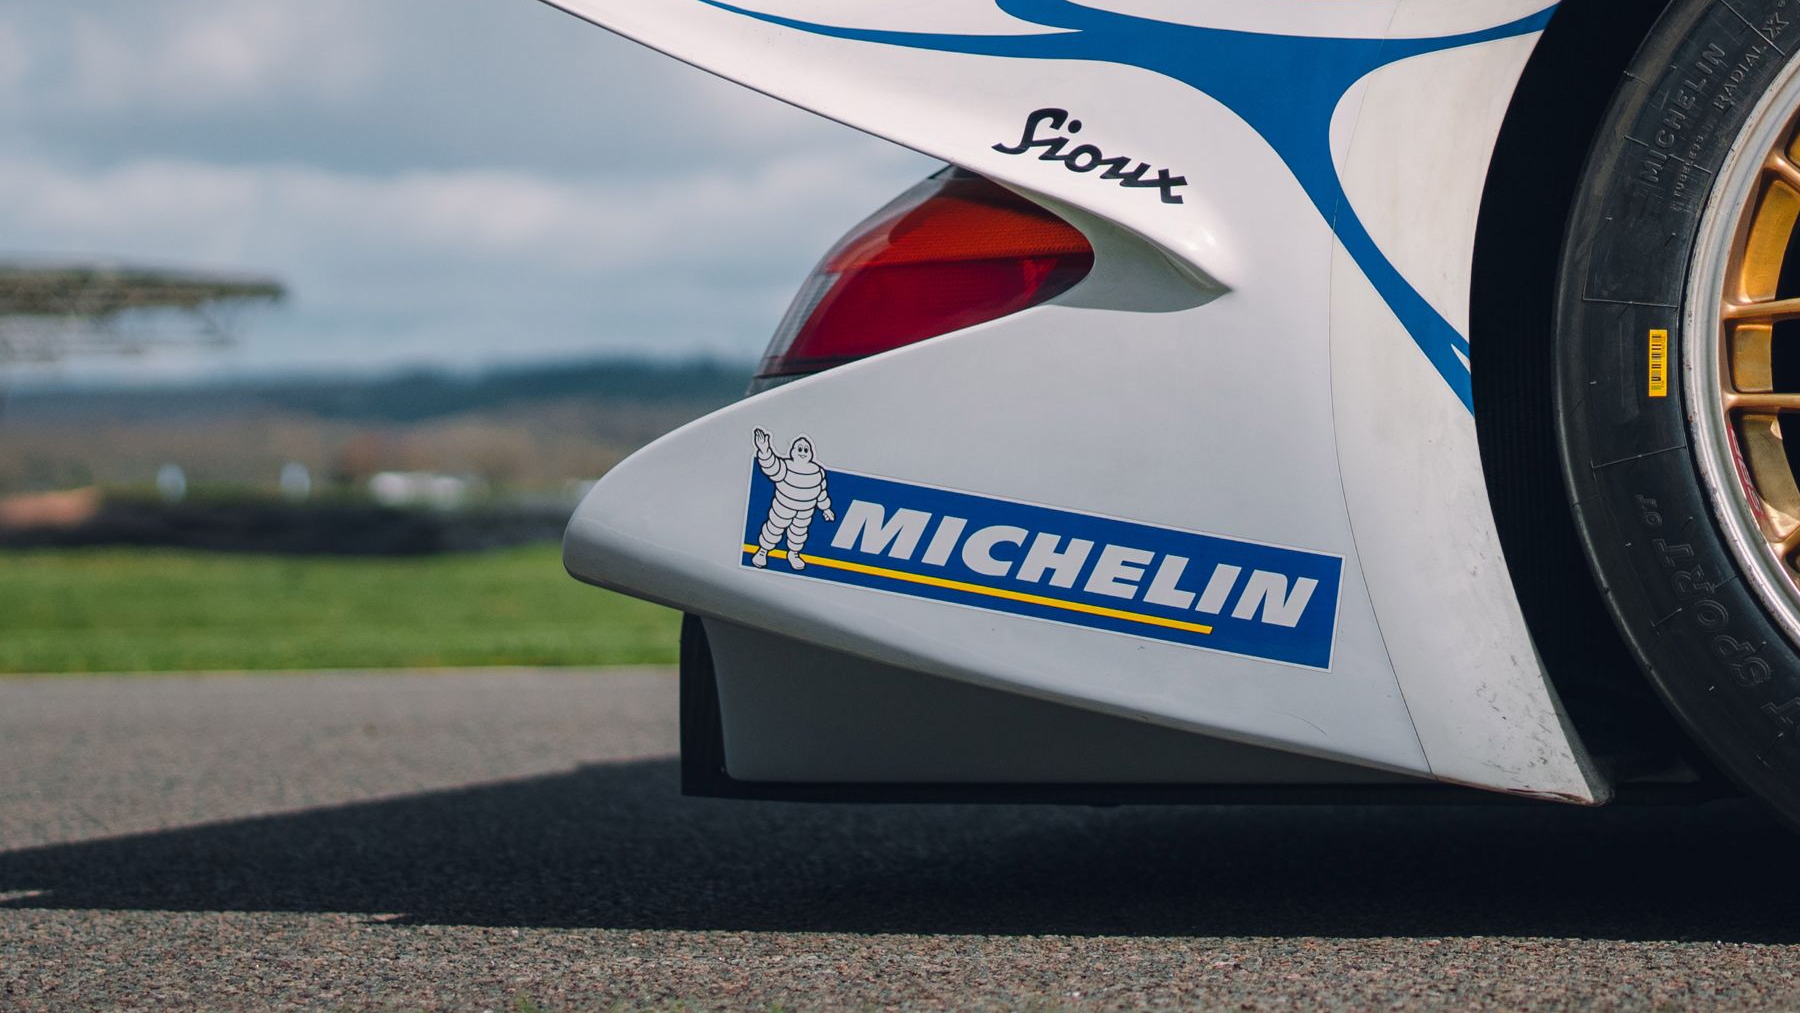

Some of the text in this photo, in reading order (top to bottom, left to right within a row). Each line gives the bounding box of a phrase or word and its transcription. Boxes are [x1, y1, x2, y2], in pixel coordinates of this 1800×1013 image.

[1640, 43, 1727, 185] MICHELIN
[1711, 43, 1764, 110] RADIAL
[991, 107, 1188, 204] Sioux
[830, 500, 1318, 628] MICHELIN
[1654, 537, 1772, 687] SPORT
